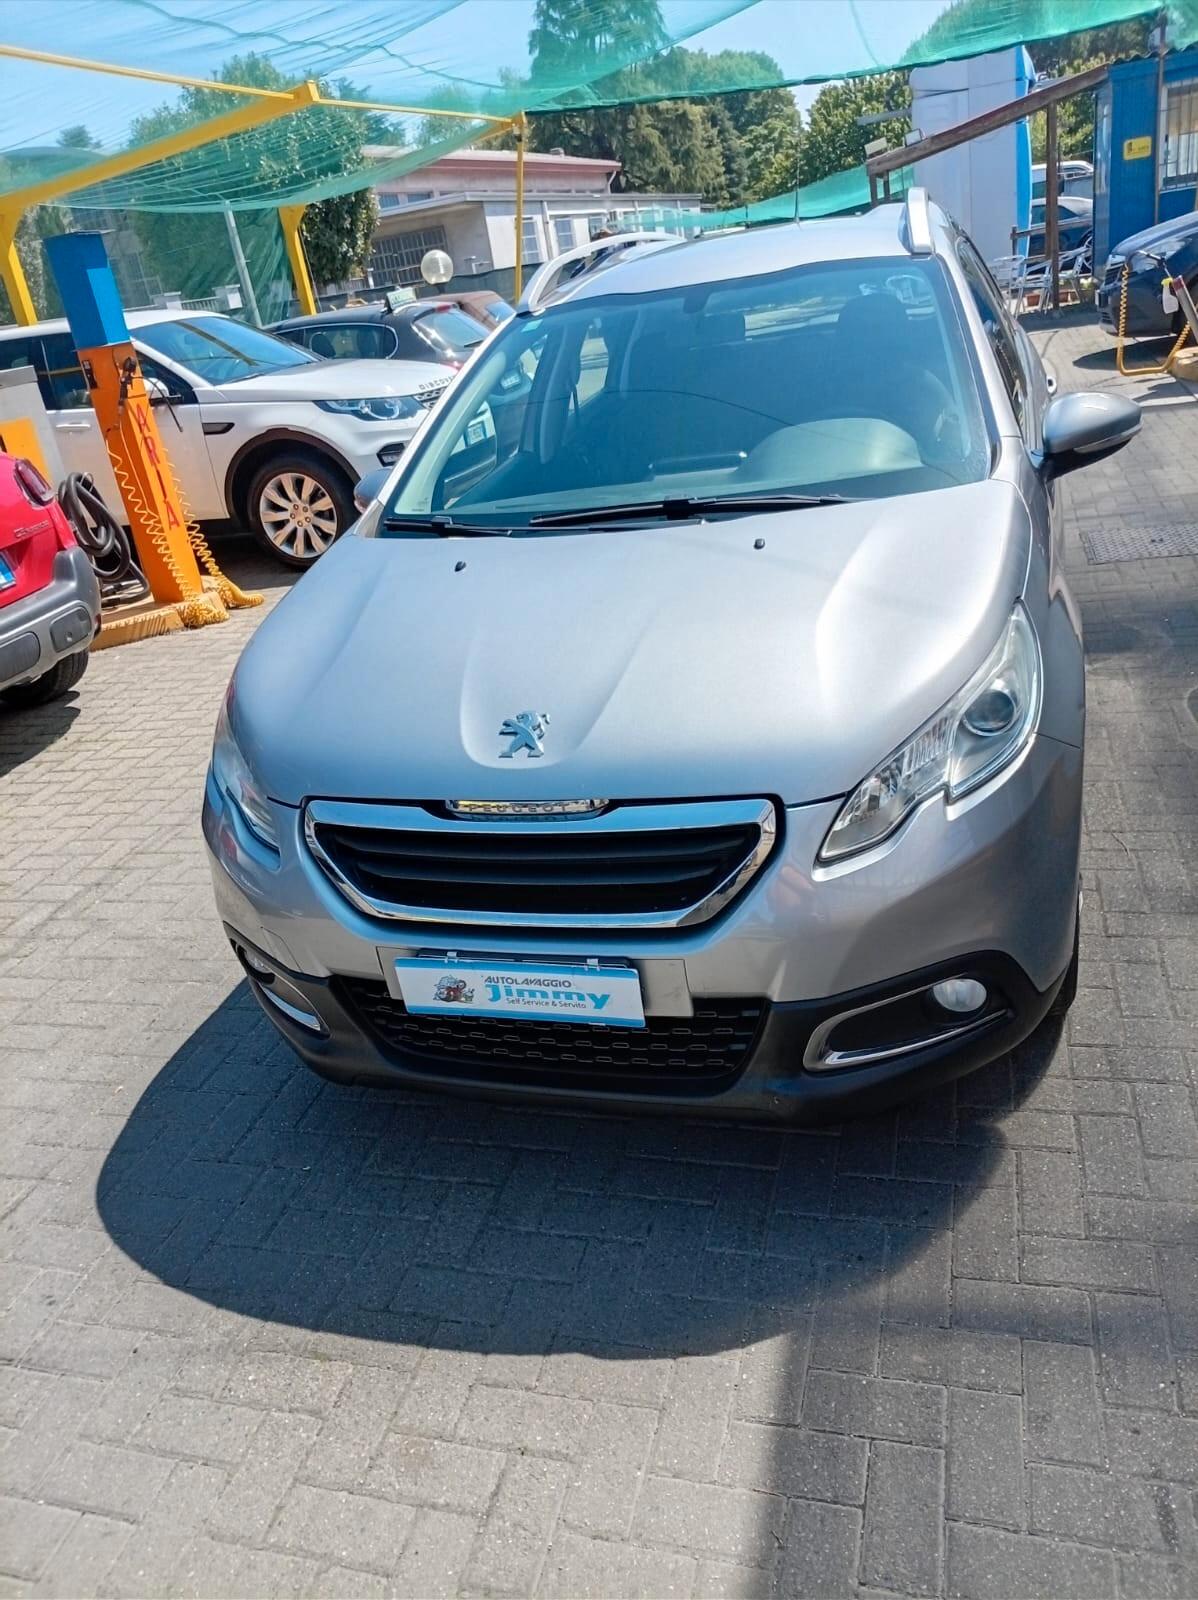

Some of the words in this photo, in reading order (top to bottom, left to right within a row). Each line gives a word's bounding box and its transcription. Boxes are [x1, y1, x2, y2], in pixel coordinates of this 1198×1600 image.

[136, 403, 180, 531] ARIA
[468, 803, 568, 813] PEUGEOT
[484, 975, 572, 988] AUTOLAVAGGIO
[485, 984, 611, 1010] Jimmy
[506, 997, 521, 1005] Self
[523, 998, 549, 1007] Service
[559, 1000, 587, 1009] Servito
